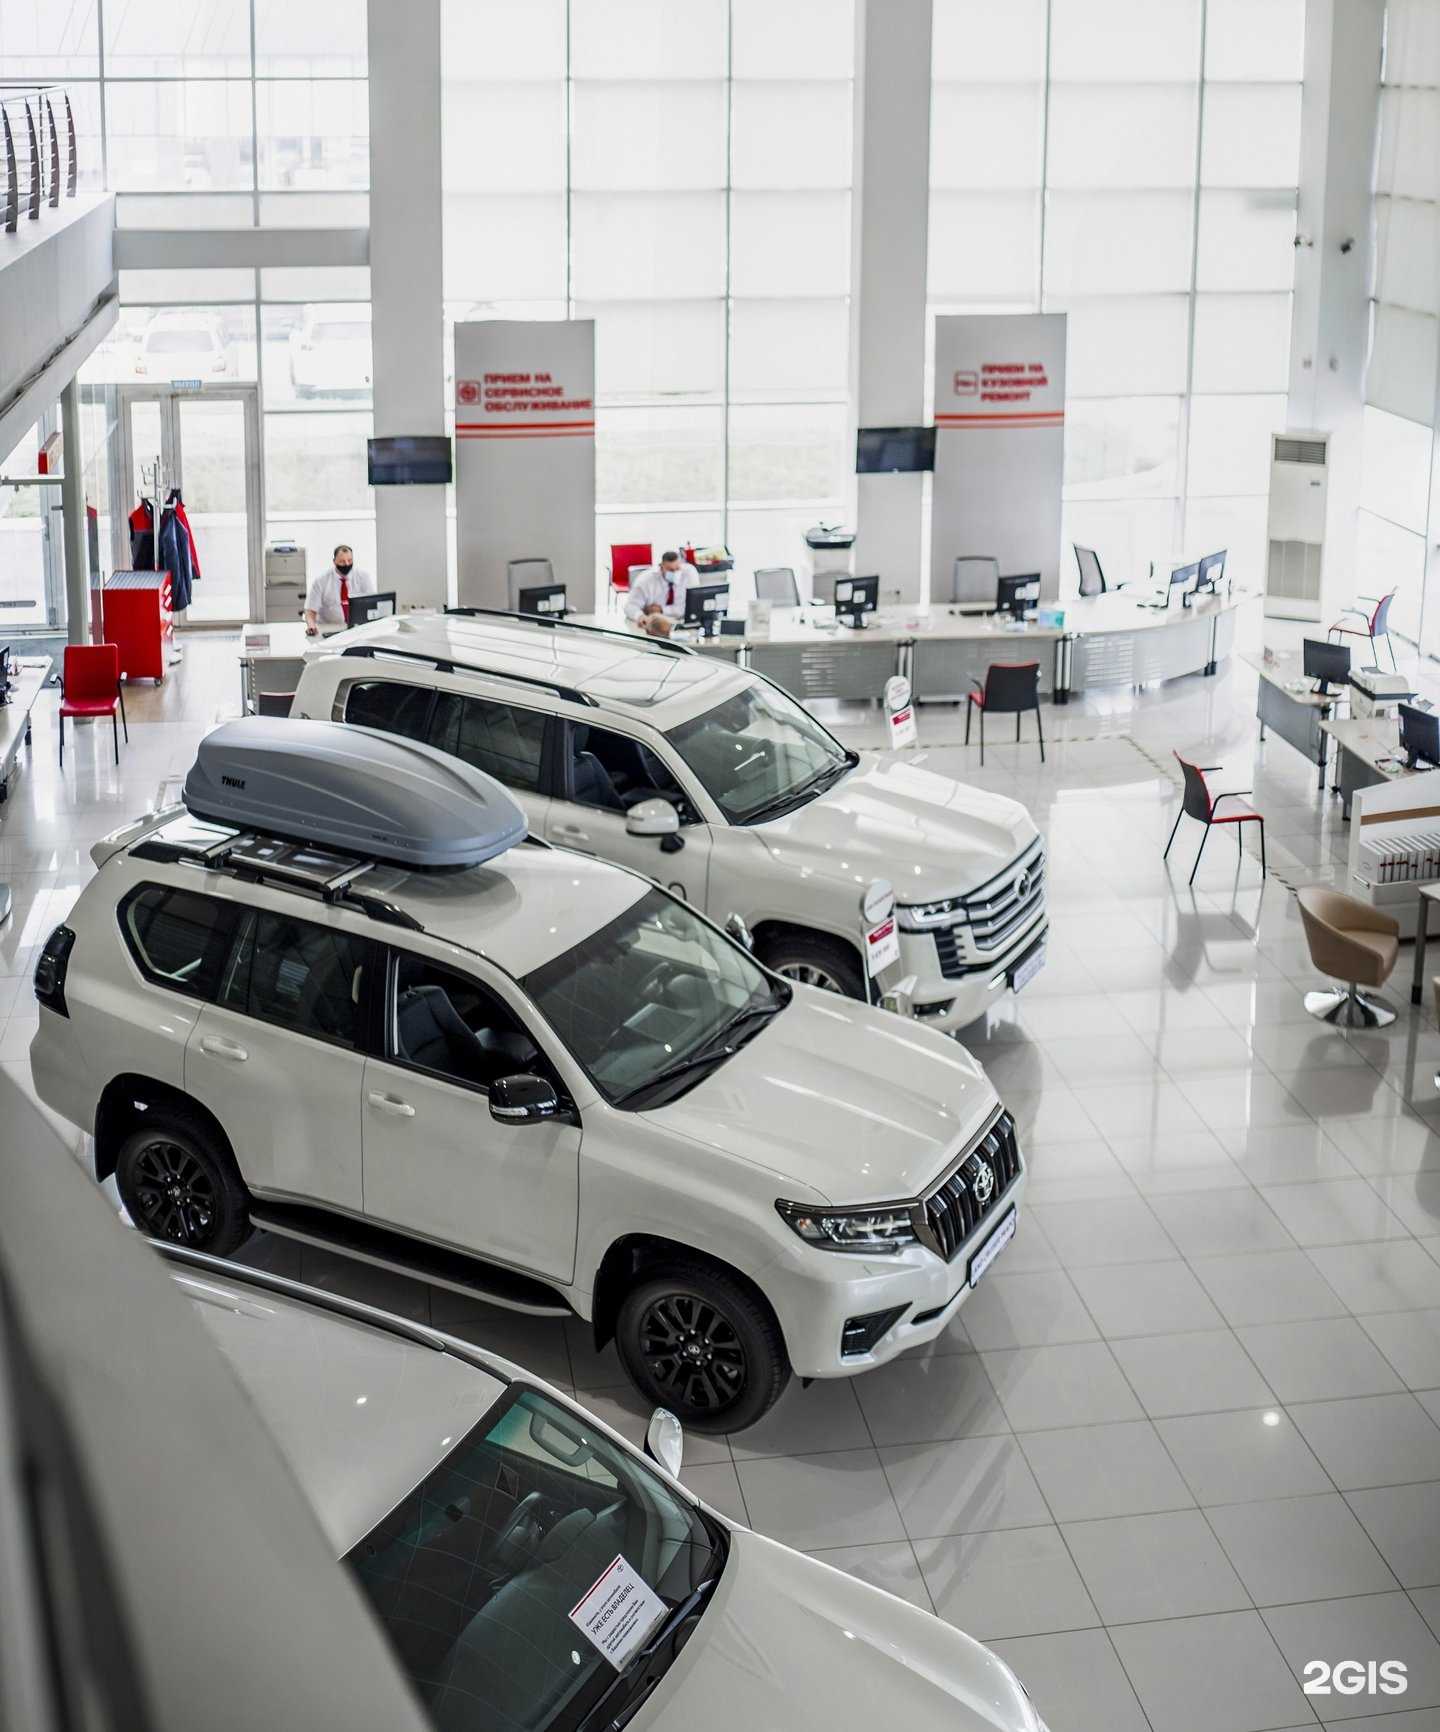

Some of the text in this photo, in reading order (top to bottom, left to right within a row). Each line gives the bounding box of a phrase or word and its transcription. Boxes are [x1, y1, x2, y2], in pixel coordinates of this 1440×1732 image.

[534, 372, 552, 383] НА
[485, 386, 563, 398] СЕРВИСНОЕ
[485, 399, 592, 412] ОБСЛУЖИВАНИЕ
[222, 775, 245, 789] THULE
[591, 1619, 605, 1635] УЖЕ
[601, 1607, 614, 1623] ЕСТЬ
[612, 1583, 635, 1610] ВЛАДЕЛЕЦ
